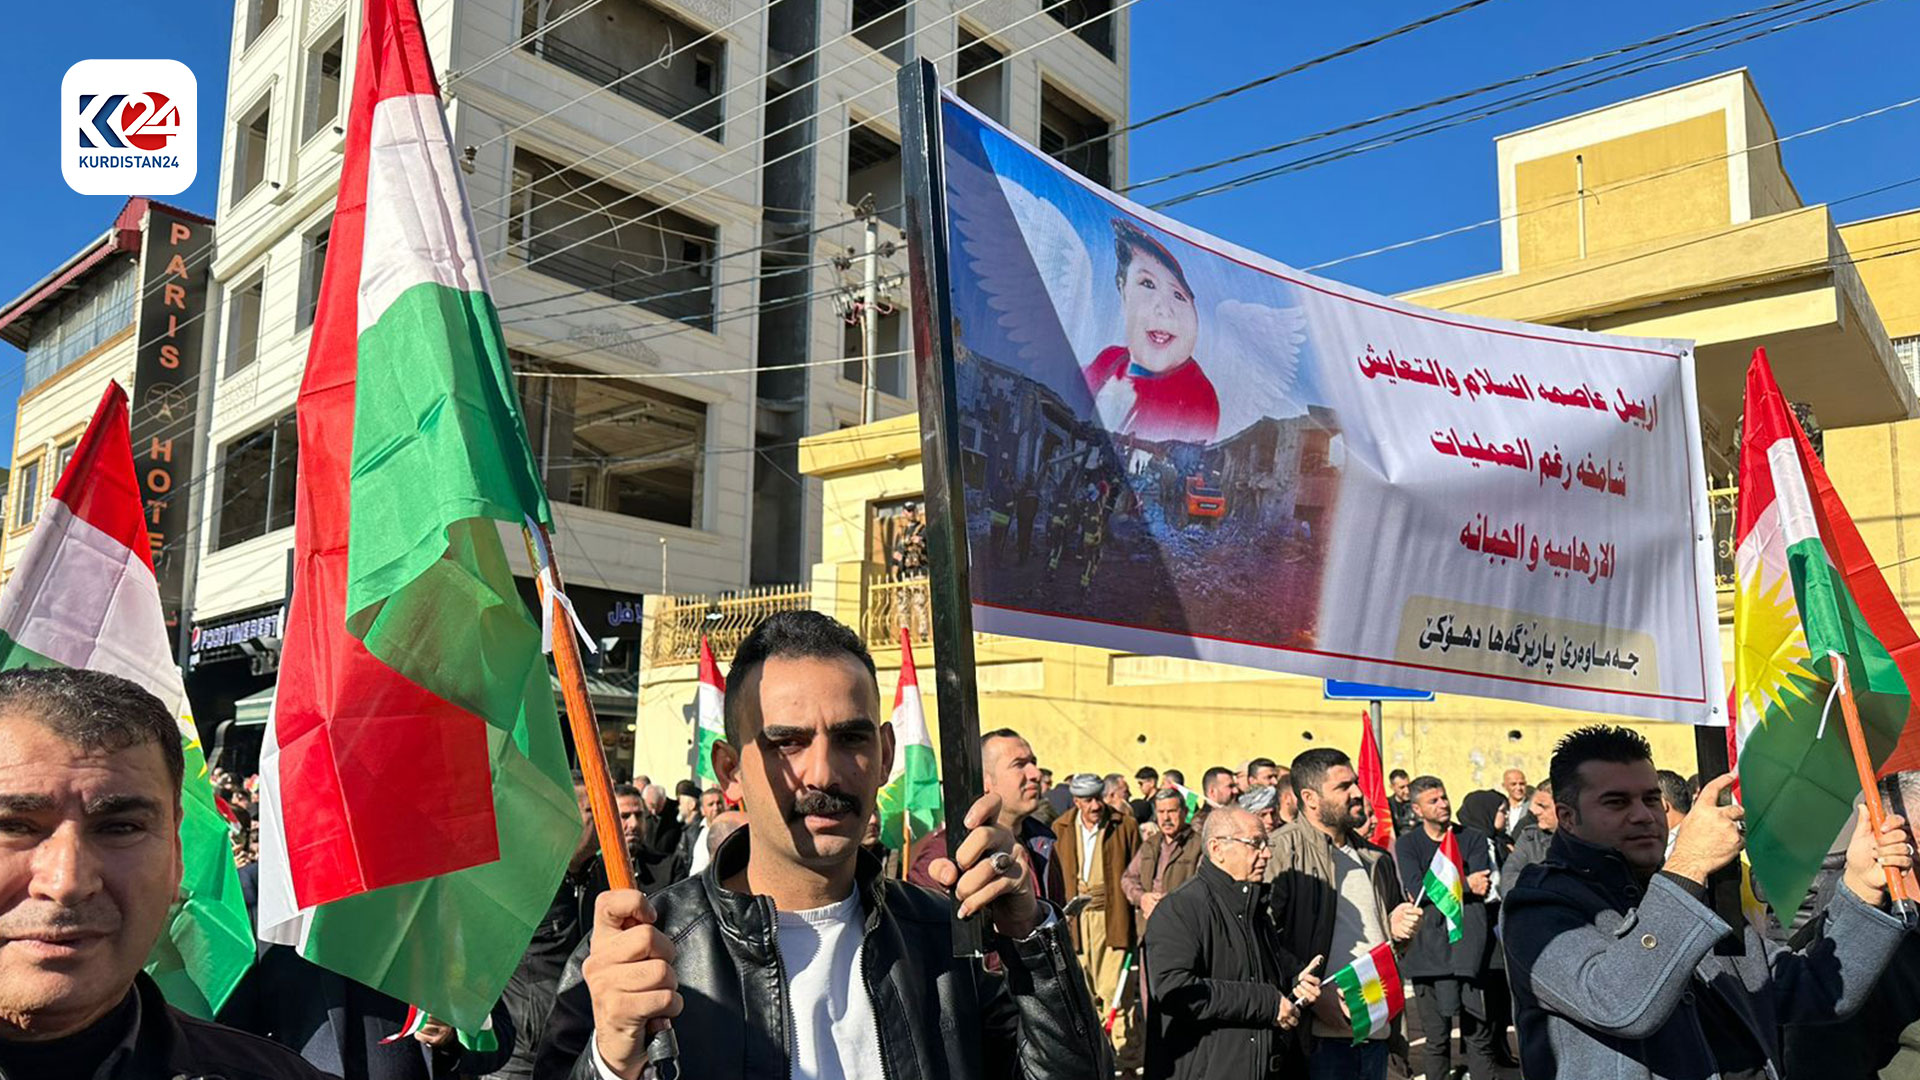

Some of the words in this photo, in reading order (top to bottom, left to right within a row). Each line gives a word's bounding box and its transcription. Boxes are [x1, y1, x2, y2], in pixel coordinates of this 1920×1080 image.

[159, 222, 191, 370] PARIS
[1357, 343, 1462, 397] والتعايش
[1462, 368, 1535, 402] السلام
[1537, 382, 1610, 413] عاصمه
[1614, 387, 1658, 432] اربيل
[1429, 427, 1534, 472] العمليات
[1539, 444, 1573, 492] رغم
[1576, 451, 1627, 497] شامخه
[146, 436, 173, 590] HOTE
[1543, 535, 1616, 585] الارهابيه
